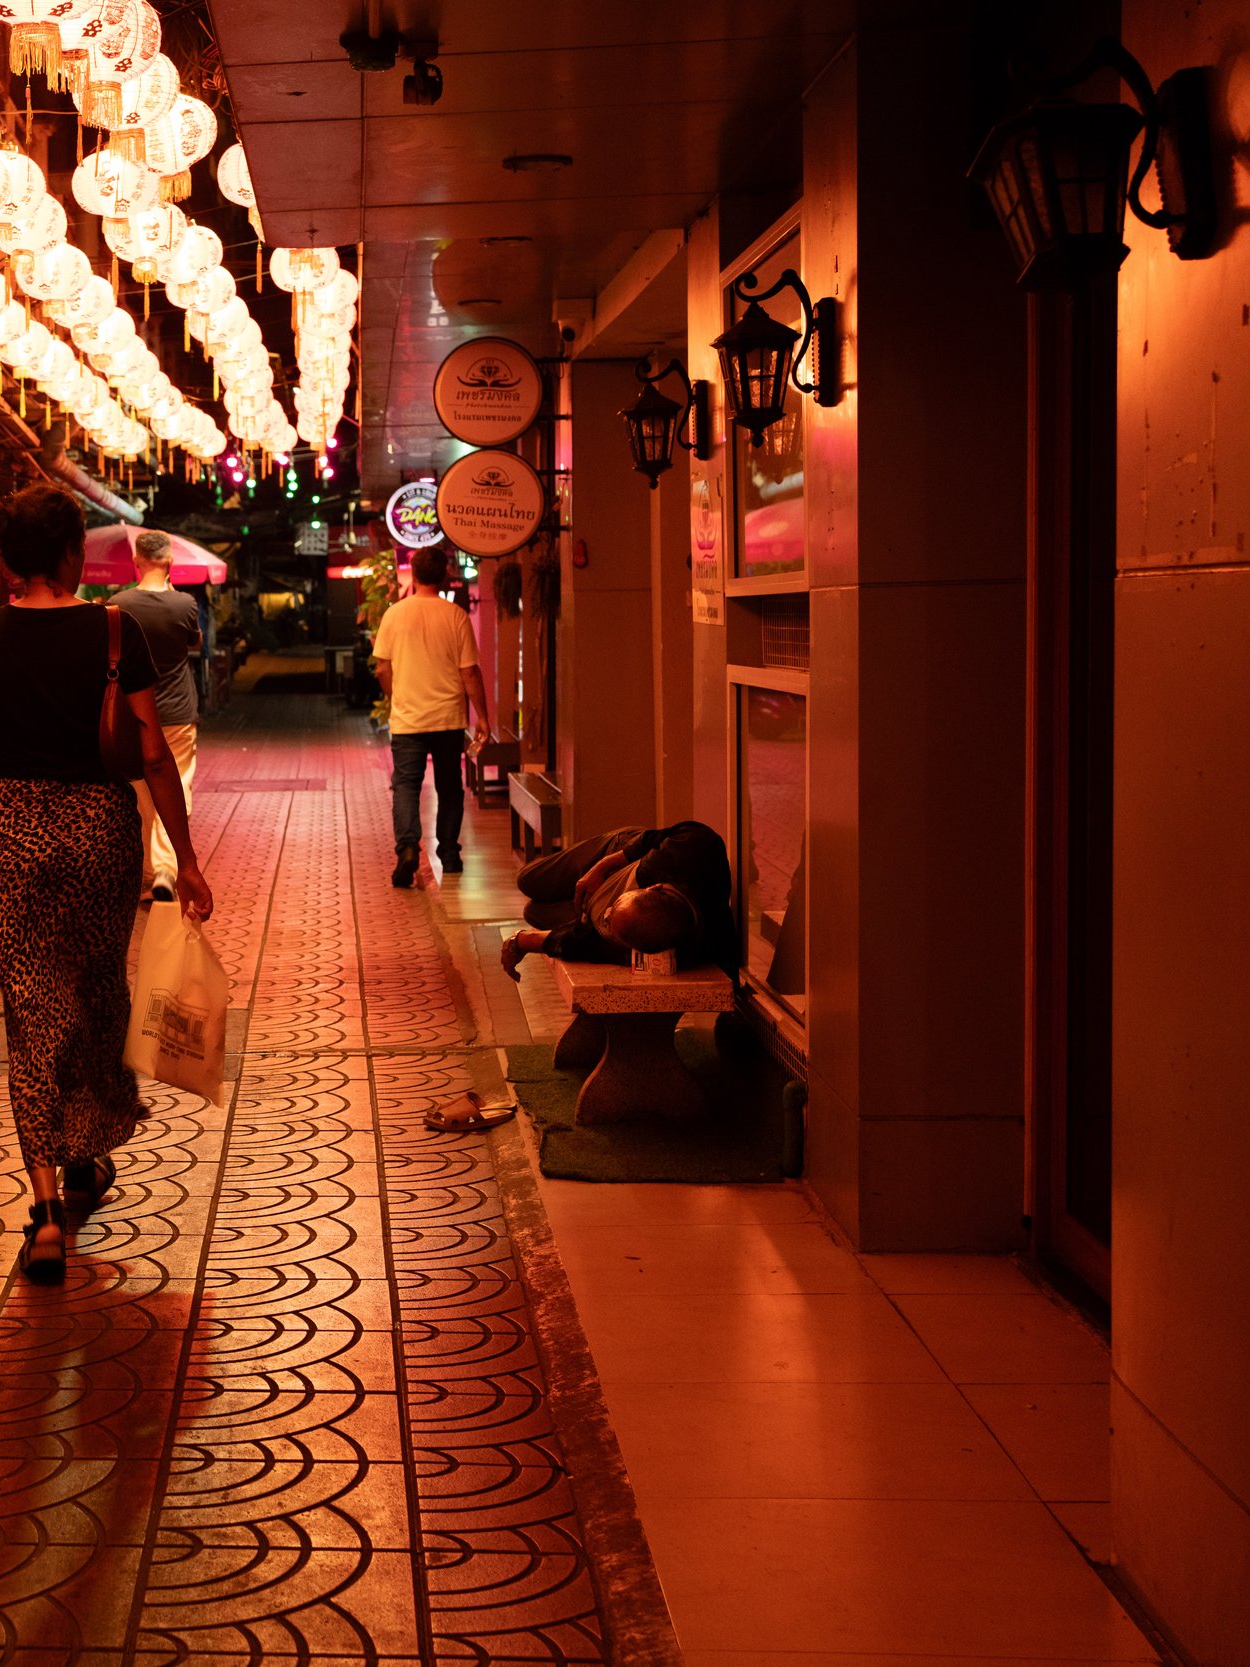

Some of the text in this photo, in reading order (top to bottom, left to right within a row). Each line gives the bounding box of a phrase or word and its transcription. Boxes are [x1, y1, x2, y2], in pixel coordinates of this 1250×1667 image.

[445, 502, 536, 521] นวดแผนไทย
[453, 517, 525, 532] Thai Massage
